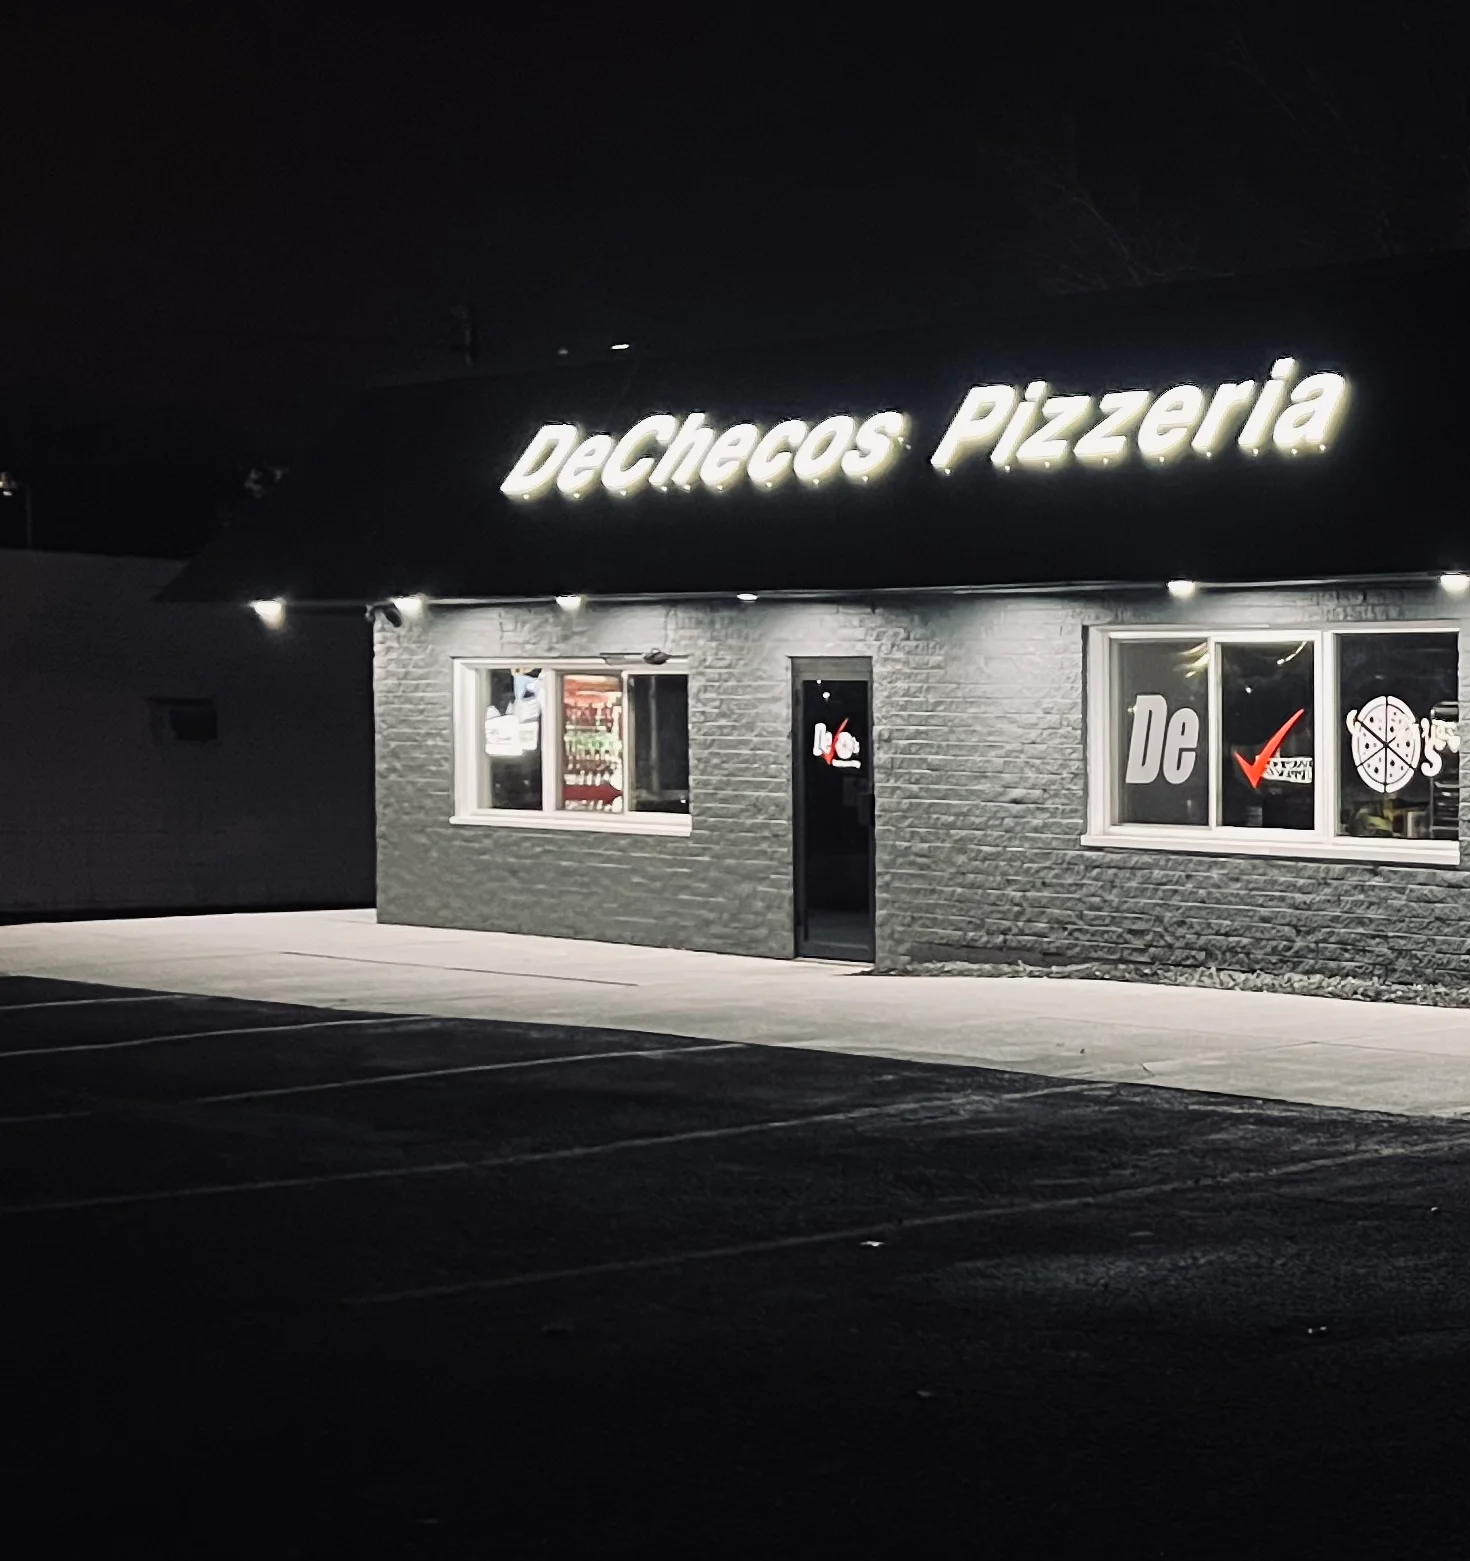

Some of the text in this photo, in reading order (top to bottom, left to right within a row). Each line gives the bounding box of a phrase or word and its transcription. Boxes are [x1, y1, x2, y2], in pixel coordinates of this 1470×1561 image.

[499, 356, 1350, 499] DeChecos Pizzeria
[1125, 694, 1200, 784] De
